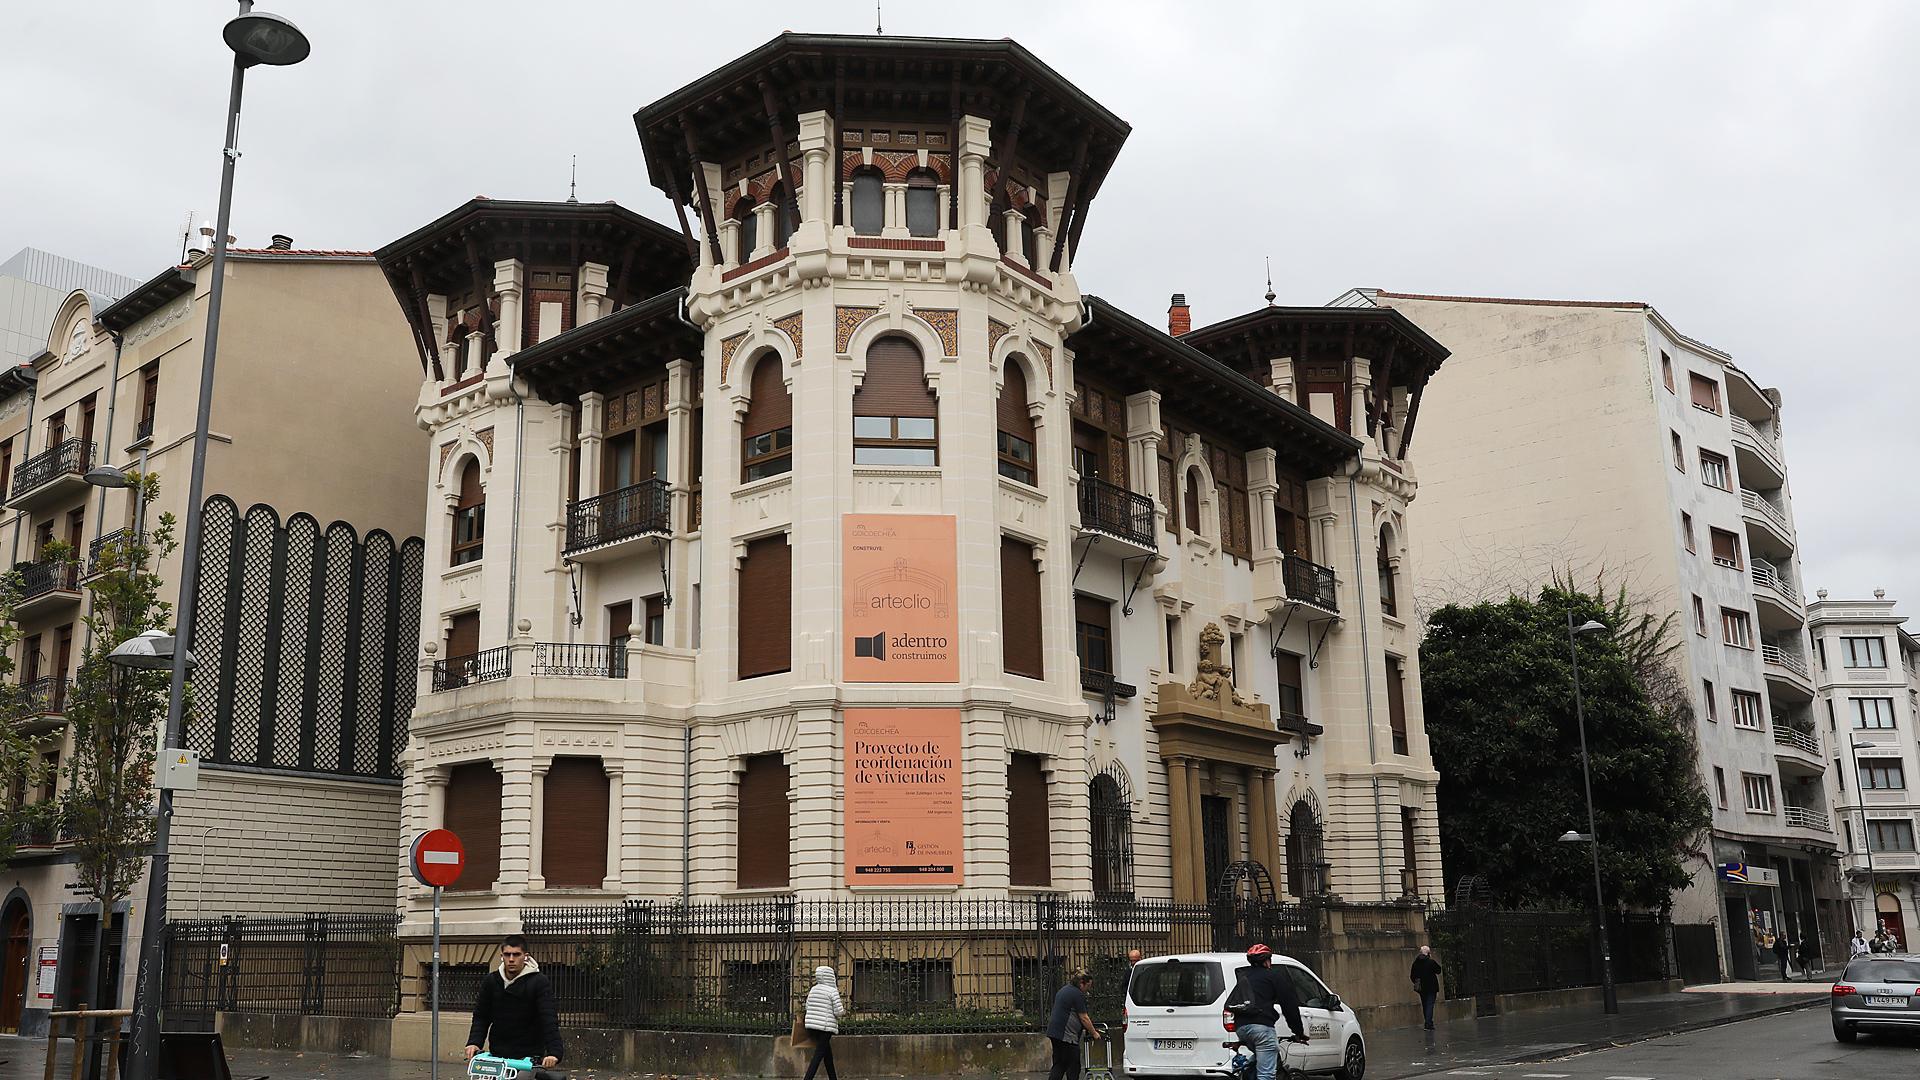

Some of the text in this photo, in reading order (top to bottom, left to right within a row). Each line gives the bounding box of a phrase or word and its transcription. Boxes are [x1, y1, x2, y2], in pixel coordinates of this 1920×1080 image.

[871, 593, 931, 609] arteclio
[891, 632, 948, 648] adentro
[891, 651, 947, 660] construimos
[855, 741, 939, 755] Proyecto de
[855, 755, 952, 769] reordenación
[855, 770, 946, 784] de viviendas
[1158, 1040, 1193, 1049] 7196 JHS
